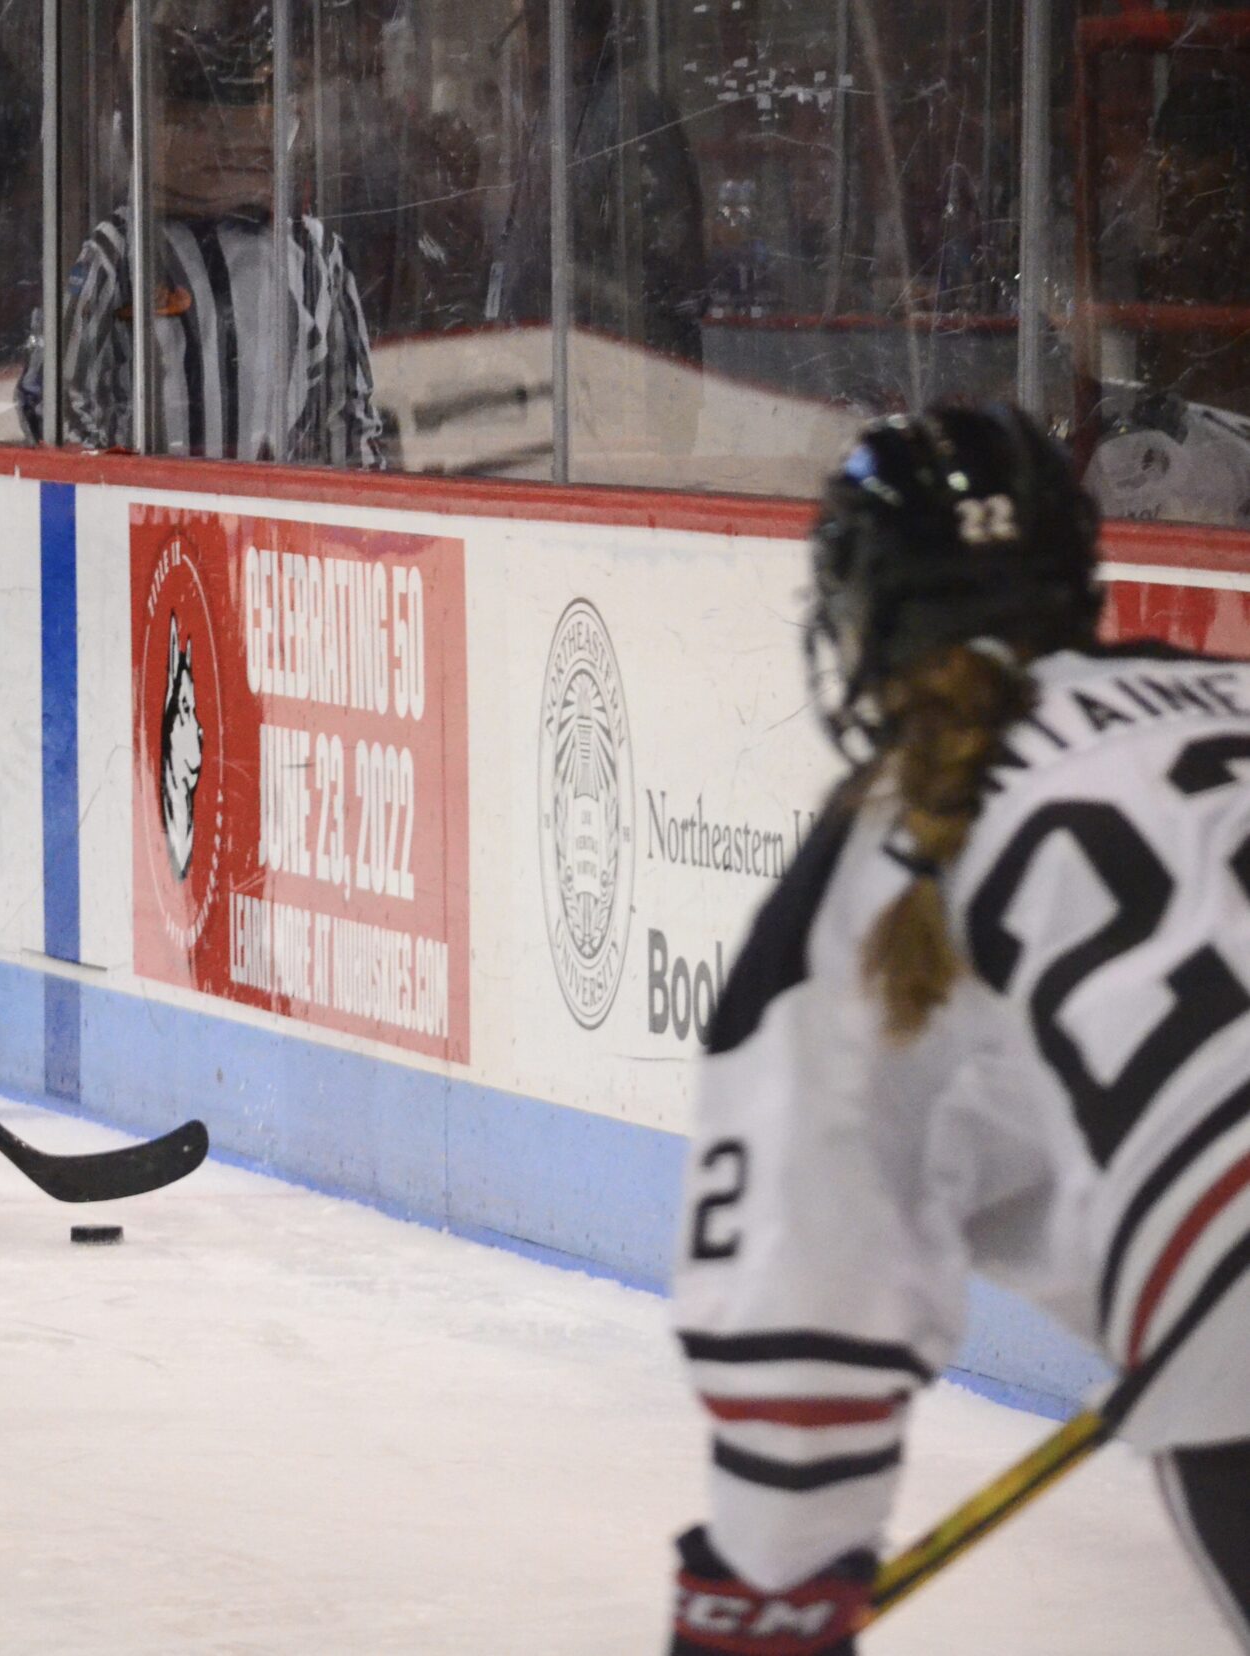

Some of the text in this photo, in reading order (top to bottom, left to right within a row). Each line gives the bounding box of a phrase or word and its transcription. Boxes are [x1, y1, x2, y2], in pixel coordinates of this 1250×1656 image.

[956, 494, 1020, 543] 22
[246, 545, 427, 721] CELEBRATING 50
[257, 723, 311, 878] JUNE
[315, 732, 351, 902] 23,
[355, 738, 415, 901] 2022
[645, 789, 786, 879] Northeastern
[229, 890, 449, 1039] LEARN MORE AT NUHUSKIES.COM
[964, 733, 1250, 1173] 2
[692, 1137, 749, 1261] 2
[670, 1588, 839, 1639] CM
